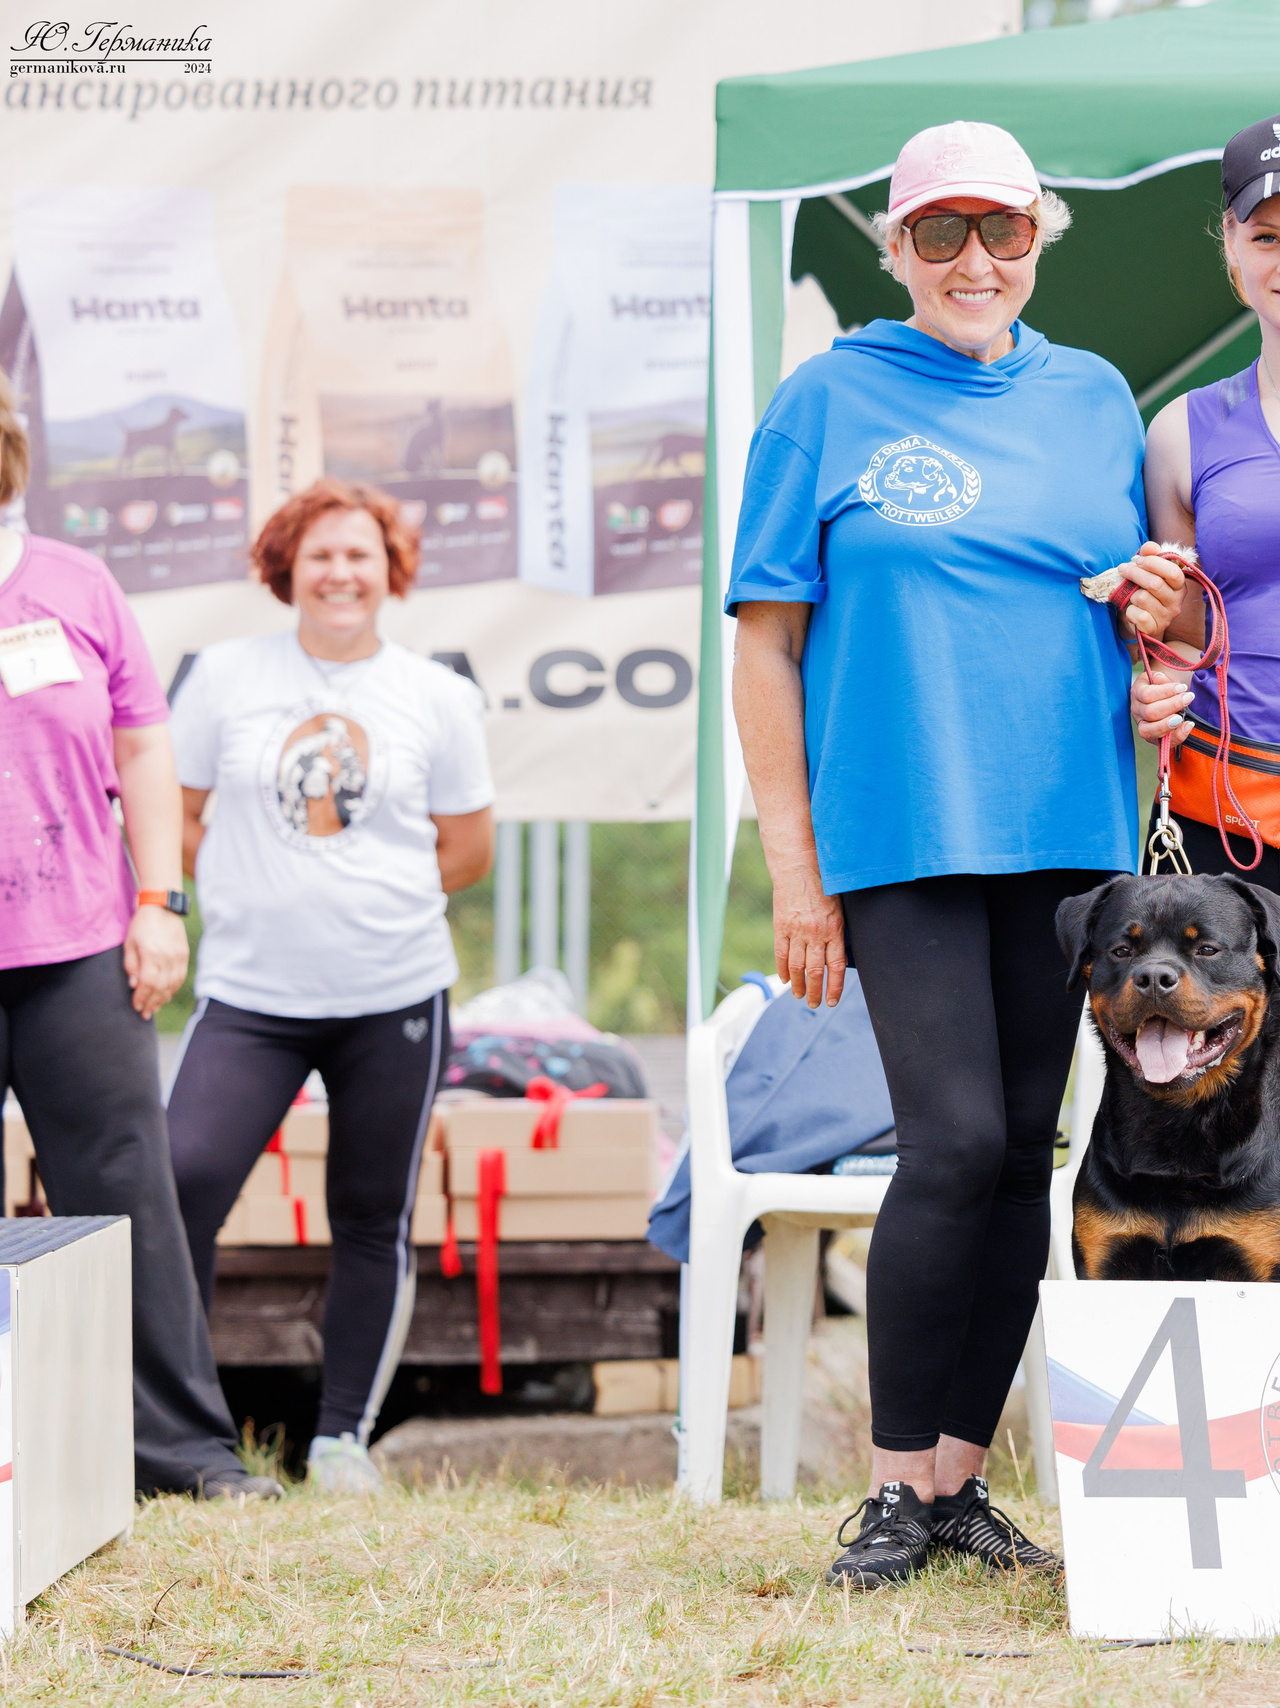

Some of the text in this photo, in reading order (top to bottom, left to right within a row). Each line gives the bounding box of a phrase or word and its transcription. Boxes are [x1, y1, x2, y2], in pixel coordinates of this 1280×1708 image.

[413, 76, 654, 110] питания
[70, 296, 201, 322] Hanta
[342, 296, 469, 321] Hanta
[872, 455, 885, 468] IZ
[881, 438, 921, 456] DOMA
[546, 412, 568, 571] Hanta
[880, 502, 964, 523] ROTTWEILER
[1225, 814, 1260, 828] SPOT
[1082, 1297, 1247, 1570] 4
